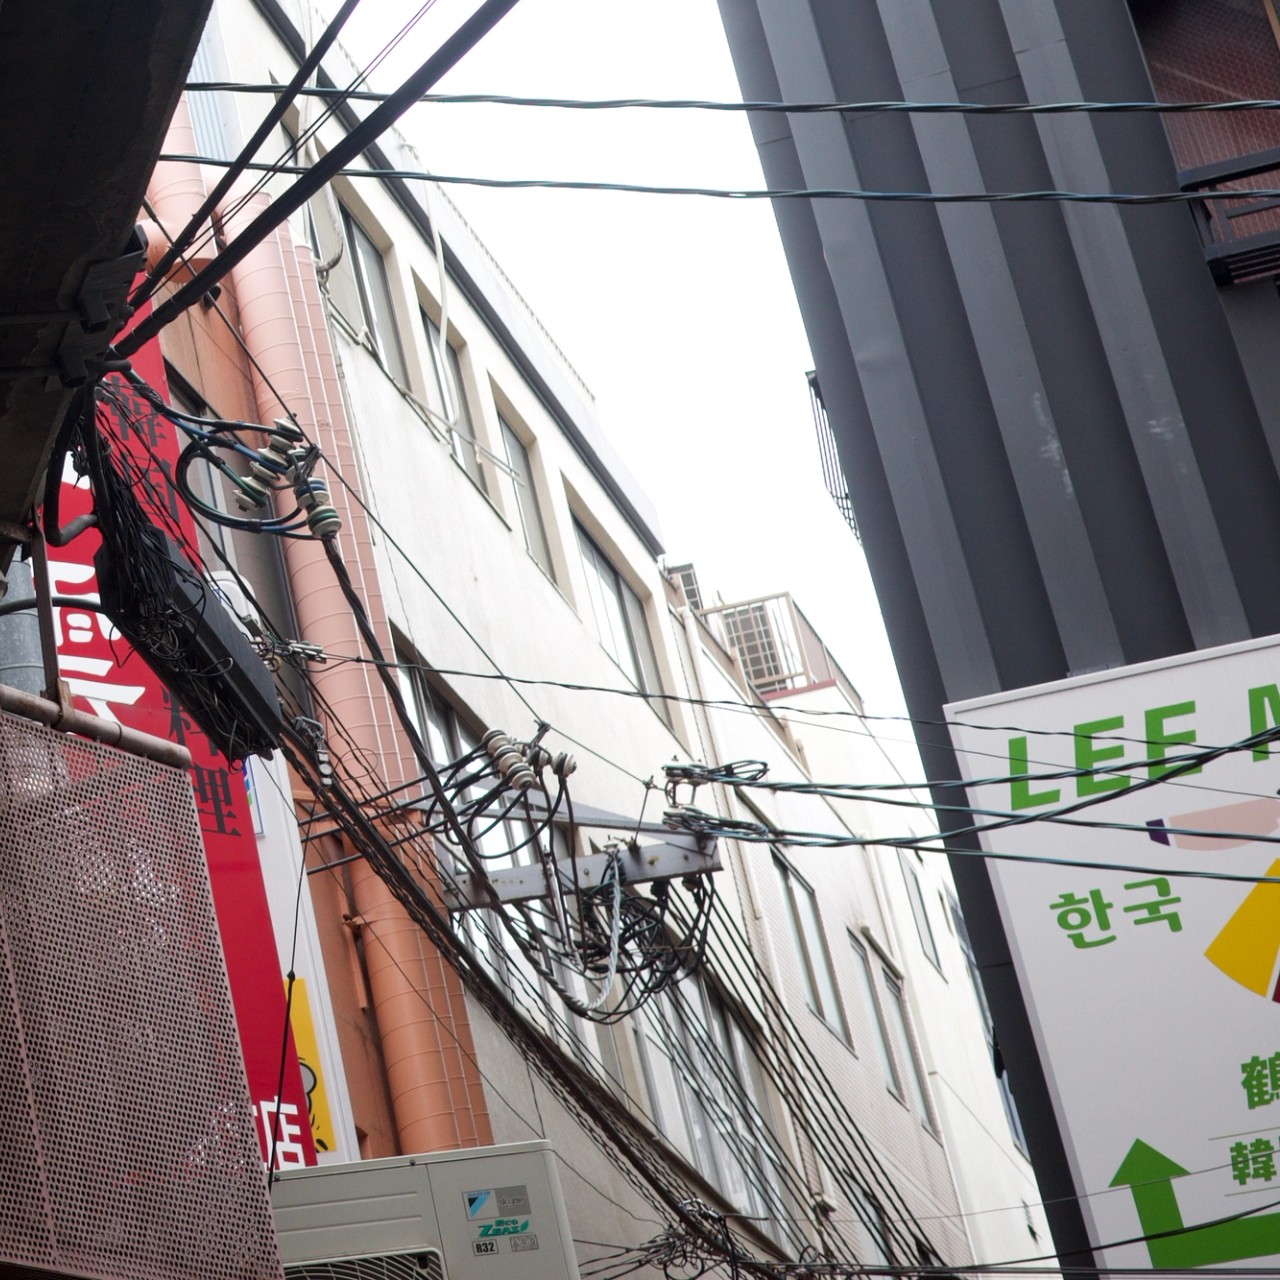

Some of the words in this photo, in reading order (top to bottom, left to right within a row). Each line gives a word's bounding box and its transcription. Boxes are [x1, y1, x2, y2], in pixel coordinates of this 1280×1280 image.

[1008, 699, 1203, 812] LEE
[1049, 876, 1183, 949] 한국
[252, 1095, 307, 1172] 店
[475, 1241, 496, 1254] R32
